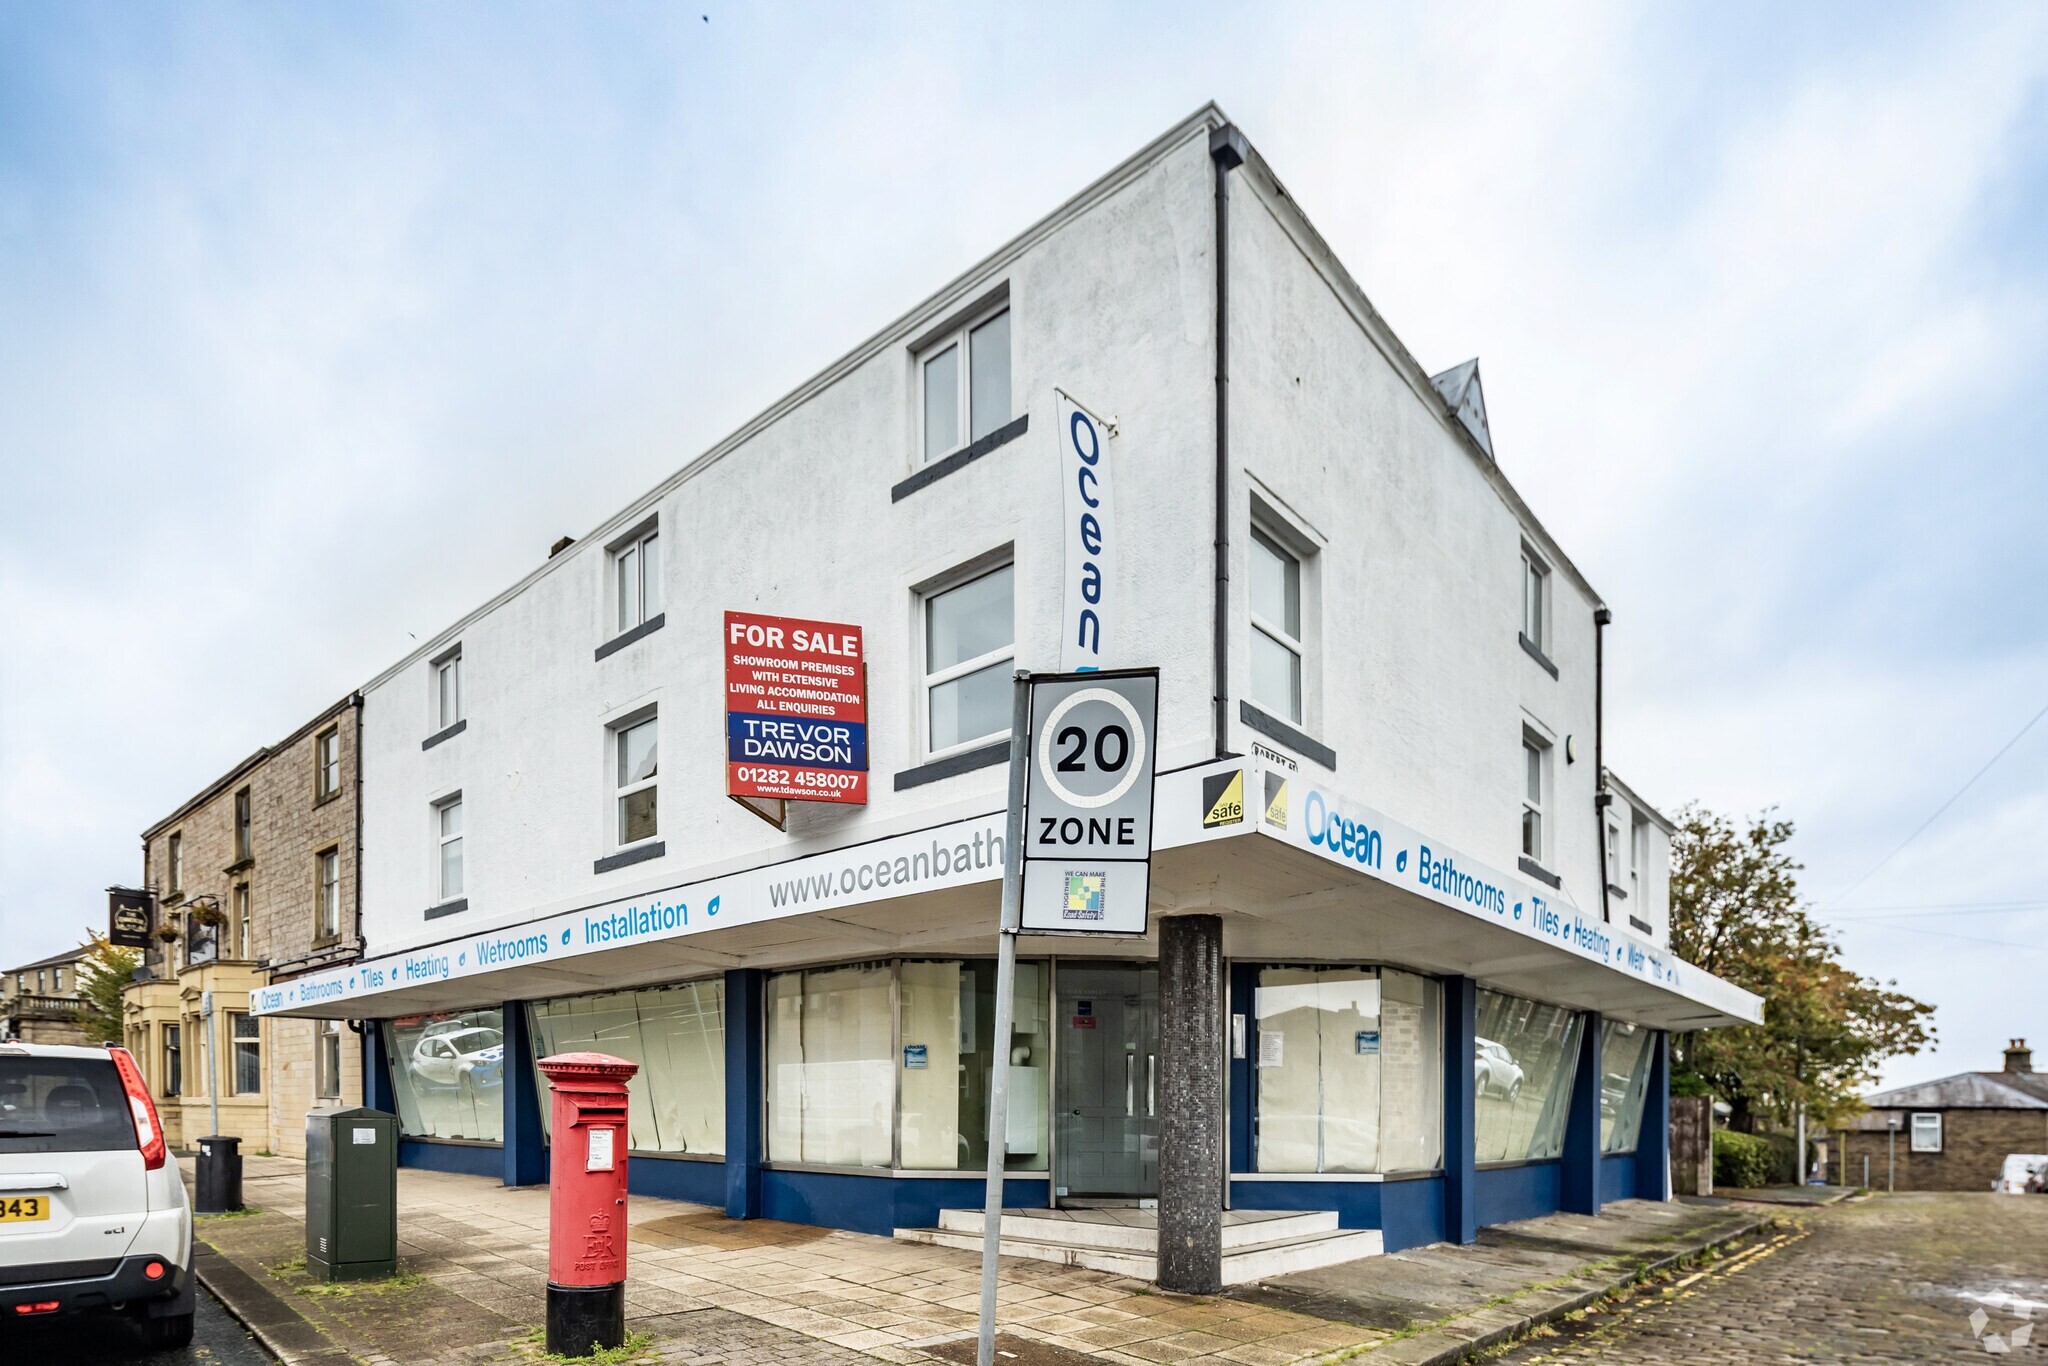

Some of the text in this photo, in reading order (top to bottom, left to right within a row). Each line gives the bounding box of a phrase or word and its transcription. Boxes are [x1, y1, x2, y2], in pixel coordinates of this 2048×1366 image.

[1070, 411, 1102, 654] Ocean
[731, 623, 858, 656] FOR SALE
[733, 655, 855, 676] SHOWROOM PREMISES
[752, 670, 838, 688] WITH EXTENSIVE
[730, 683, 860, 704] LIVING ACCOMMODATION
[757, 700, 835, 715] ALL ENQUIRIES
[743, 719, 850, 744] TREVOR
[744, 739, 851, 763] DAWSON
[1056, 725, 1129, 772] 20
[738, 767, 858, 790] 01282 458007
[757, 785, 841, 798] www.tdawson.co.uk
[1213, 803, 1241, 819] safe
[1270, 807, 1286, 822] safe
[1039, 818, 1135, 845] ZONE
[1305, 790, 1382, 870] Ocean
[1419, 845, 1505, 915] Bathrooms
[1532, 897, 1559, 936] Tiles
[1573, 916, 1610, 963] Heating
[261, 902, 688, 1010] Ocean Bathrooms Tiles Heating Wetrooms Installation
[574, 1262, 596, 1271] POST
